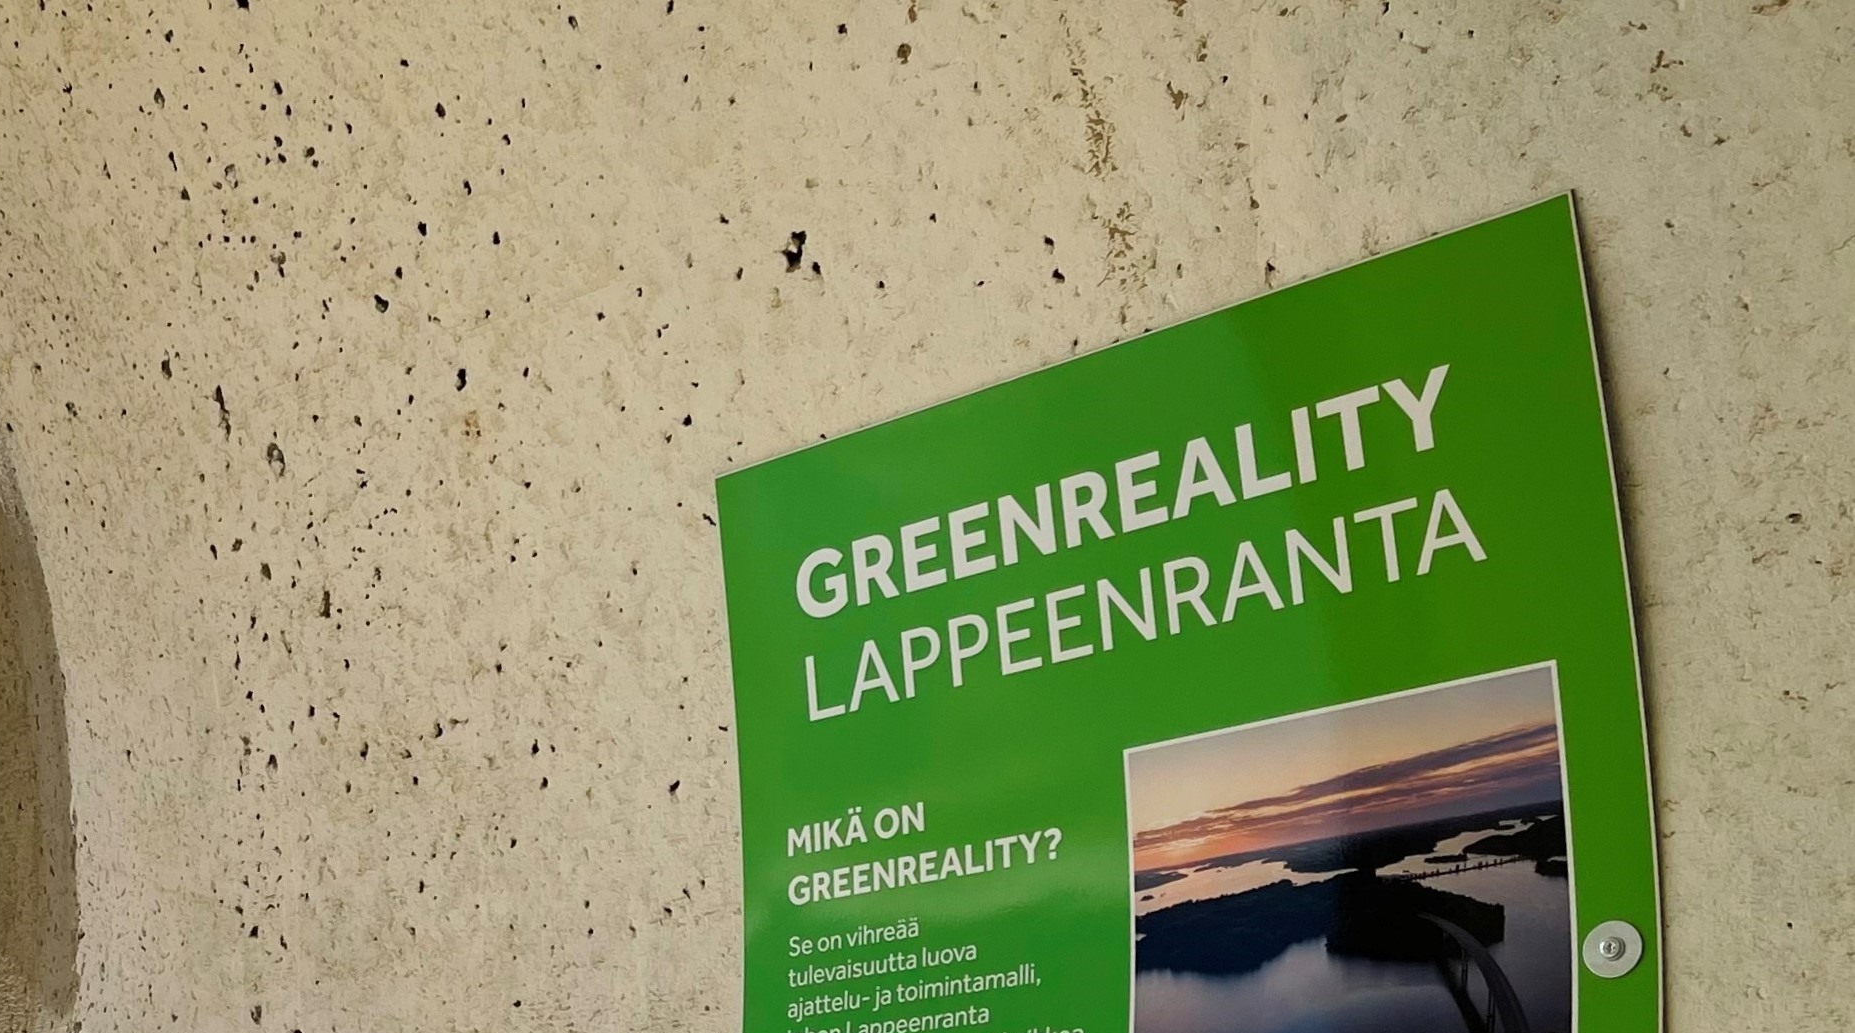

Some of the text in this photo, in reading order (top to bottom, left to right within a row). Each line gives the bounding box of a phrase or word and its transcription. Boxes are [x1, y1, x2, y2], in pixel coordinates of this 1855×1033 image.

[796, 364, 1451, 618] GREENREALITY
[804, 488, 1488, 722] LAPPEENRANTA
[787, 802, 925, 857] MIKÄ ON
[788, 827, 1062, 906] GREENREALITY?
[788, 943, 977, 987] tulevaisuutta luova
[789, 918, 919, 956] Se on vihreää
[788, 964, 1041, 1022] ajattelu- ja toimintamalli,
